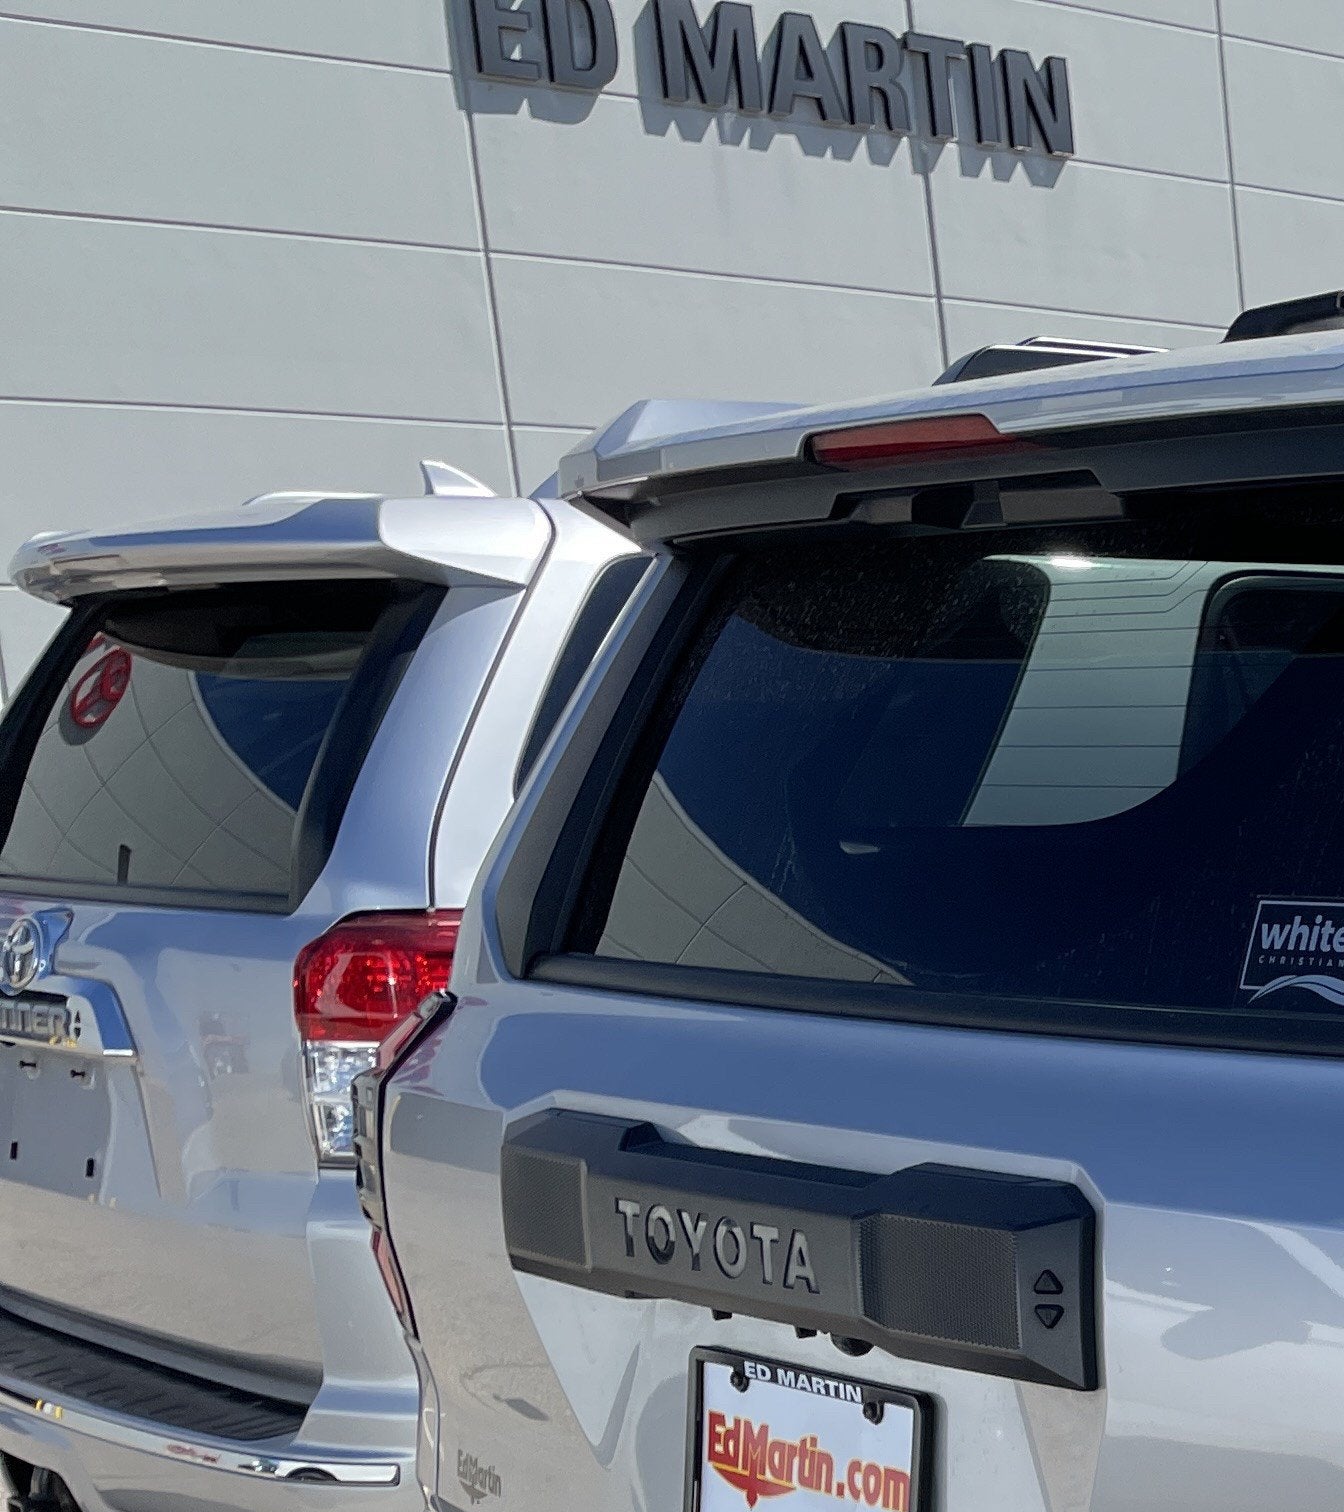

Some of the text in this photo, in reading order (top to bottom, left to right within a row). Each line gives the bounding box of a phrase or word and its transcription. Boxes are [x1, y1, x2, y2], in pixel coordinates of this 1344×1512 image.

[474, 0, 1075, 157] ED MARTIN
[1258, 954, 1344, 968] CHRISTIAN
[615, 1198, 821, 1294] TOYOTA
[743, 1360, 863, 1404] ED MARTIN
